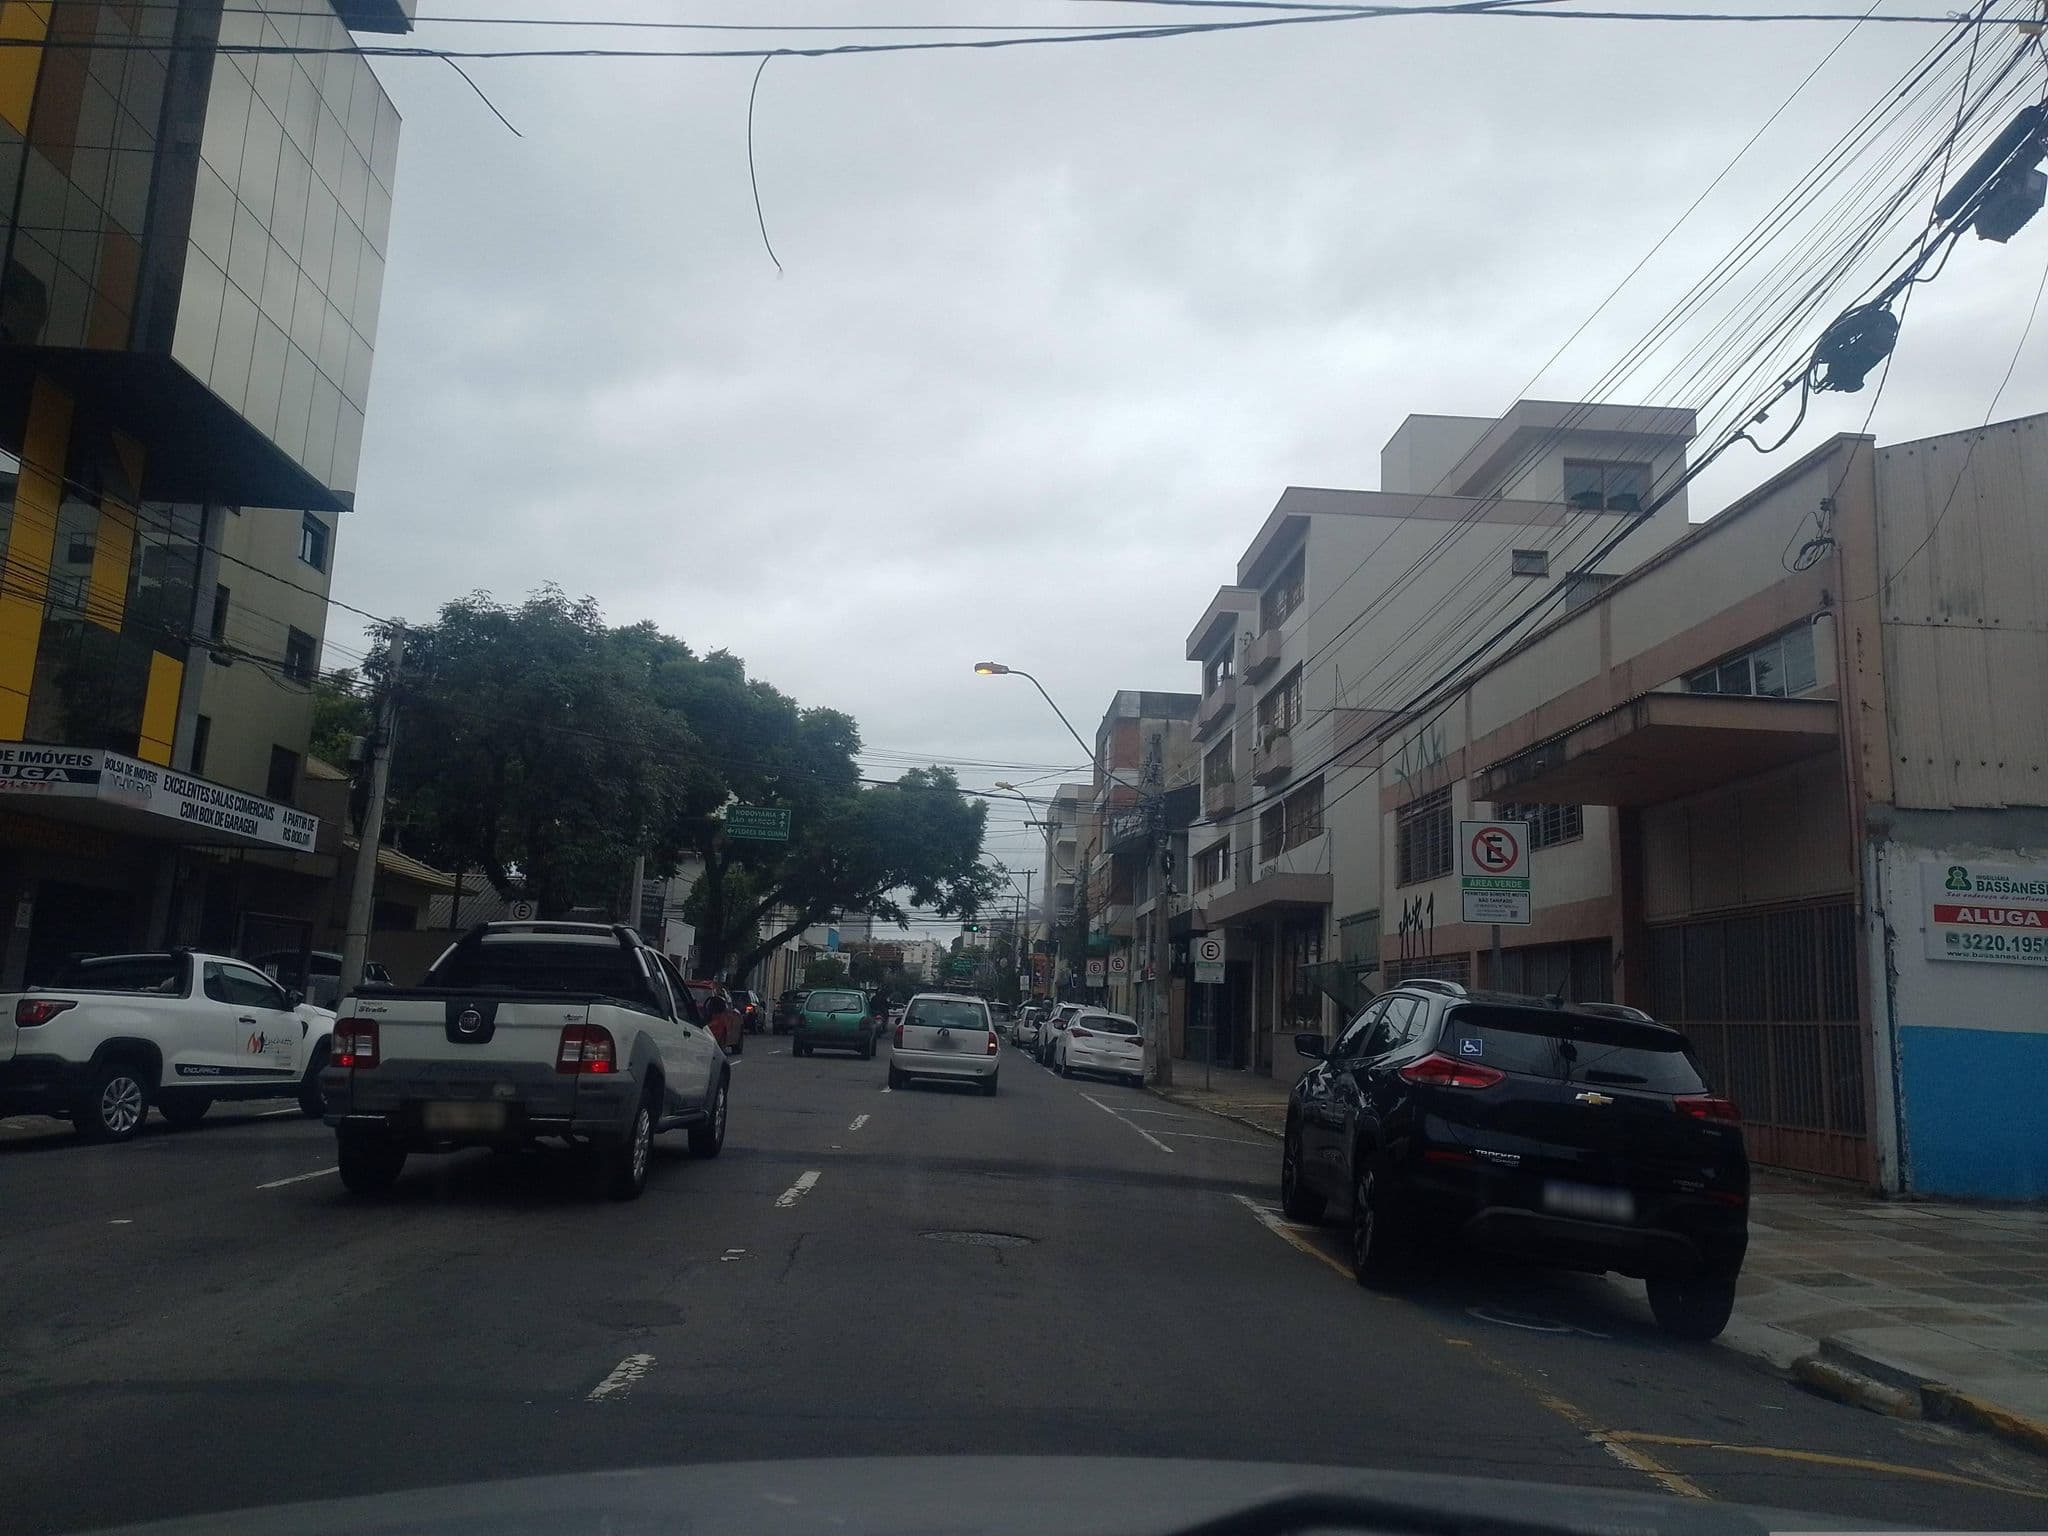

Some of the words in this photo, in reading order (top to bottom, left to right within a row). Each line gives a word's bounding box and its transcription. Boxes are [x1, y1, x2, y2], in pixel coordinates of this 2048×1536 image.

[19, 749, 93, 766] IMÓVEIS
[105, 758, 124, 774] BOLSA
[125, 763, 134, 777] DE
[164, 774, 210, 803] EXCELENTES
[210, 788, 234, 810] SALAS
[234, 796, 275, 821] COMERCIAIS
[180, 801, 199, 820] COM
[199, 805, 215, 824] BOX
[214, 810, 225, 827] DE
[224, 813, 258, 836] GARAGEM
[282, 810, 288, 825] A
[288, 812, 307, 831] PARTIR
[307, 817, 316, 832] DE
[1487, 836, 1503, 863] E
[1496, 880, 1522, 888] VERDE
[1956, 907, 2042, 926] ALUGA
[1206, 944, 1214, 957] E
